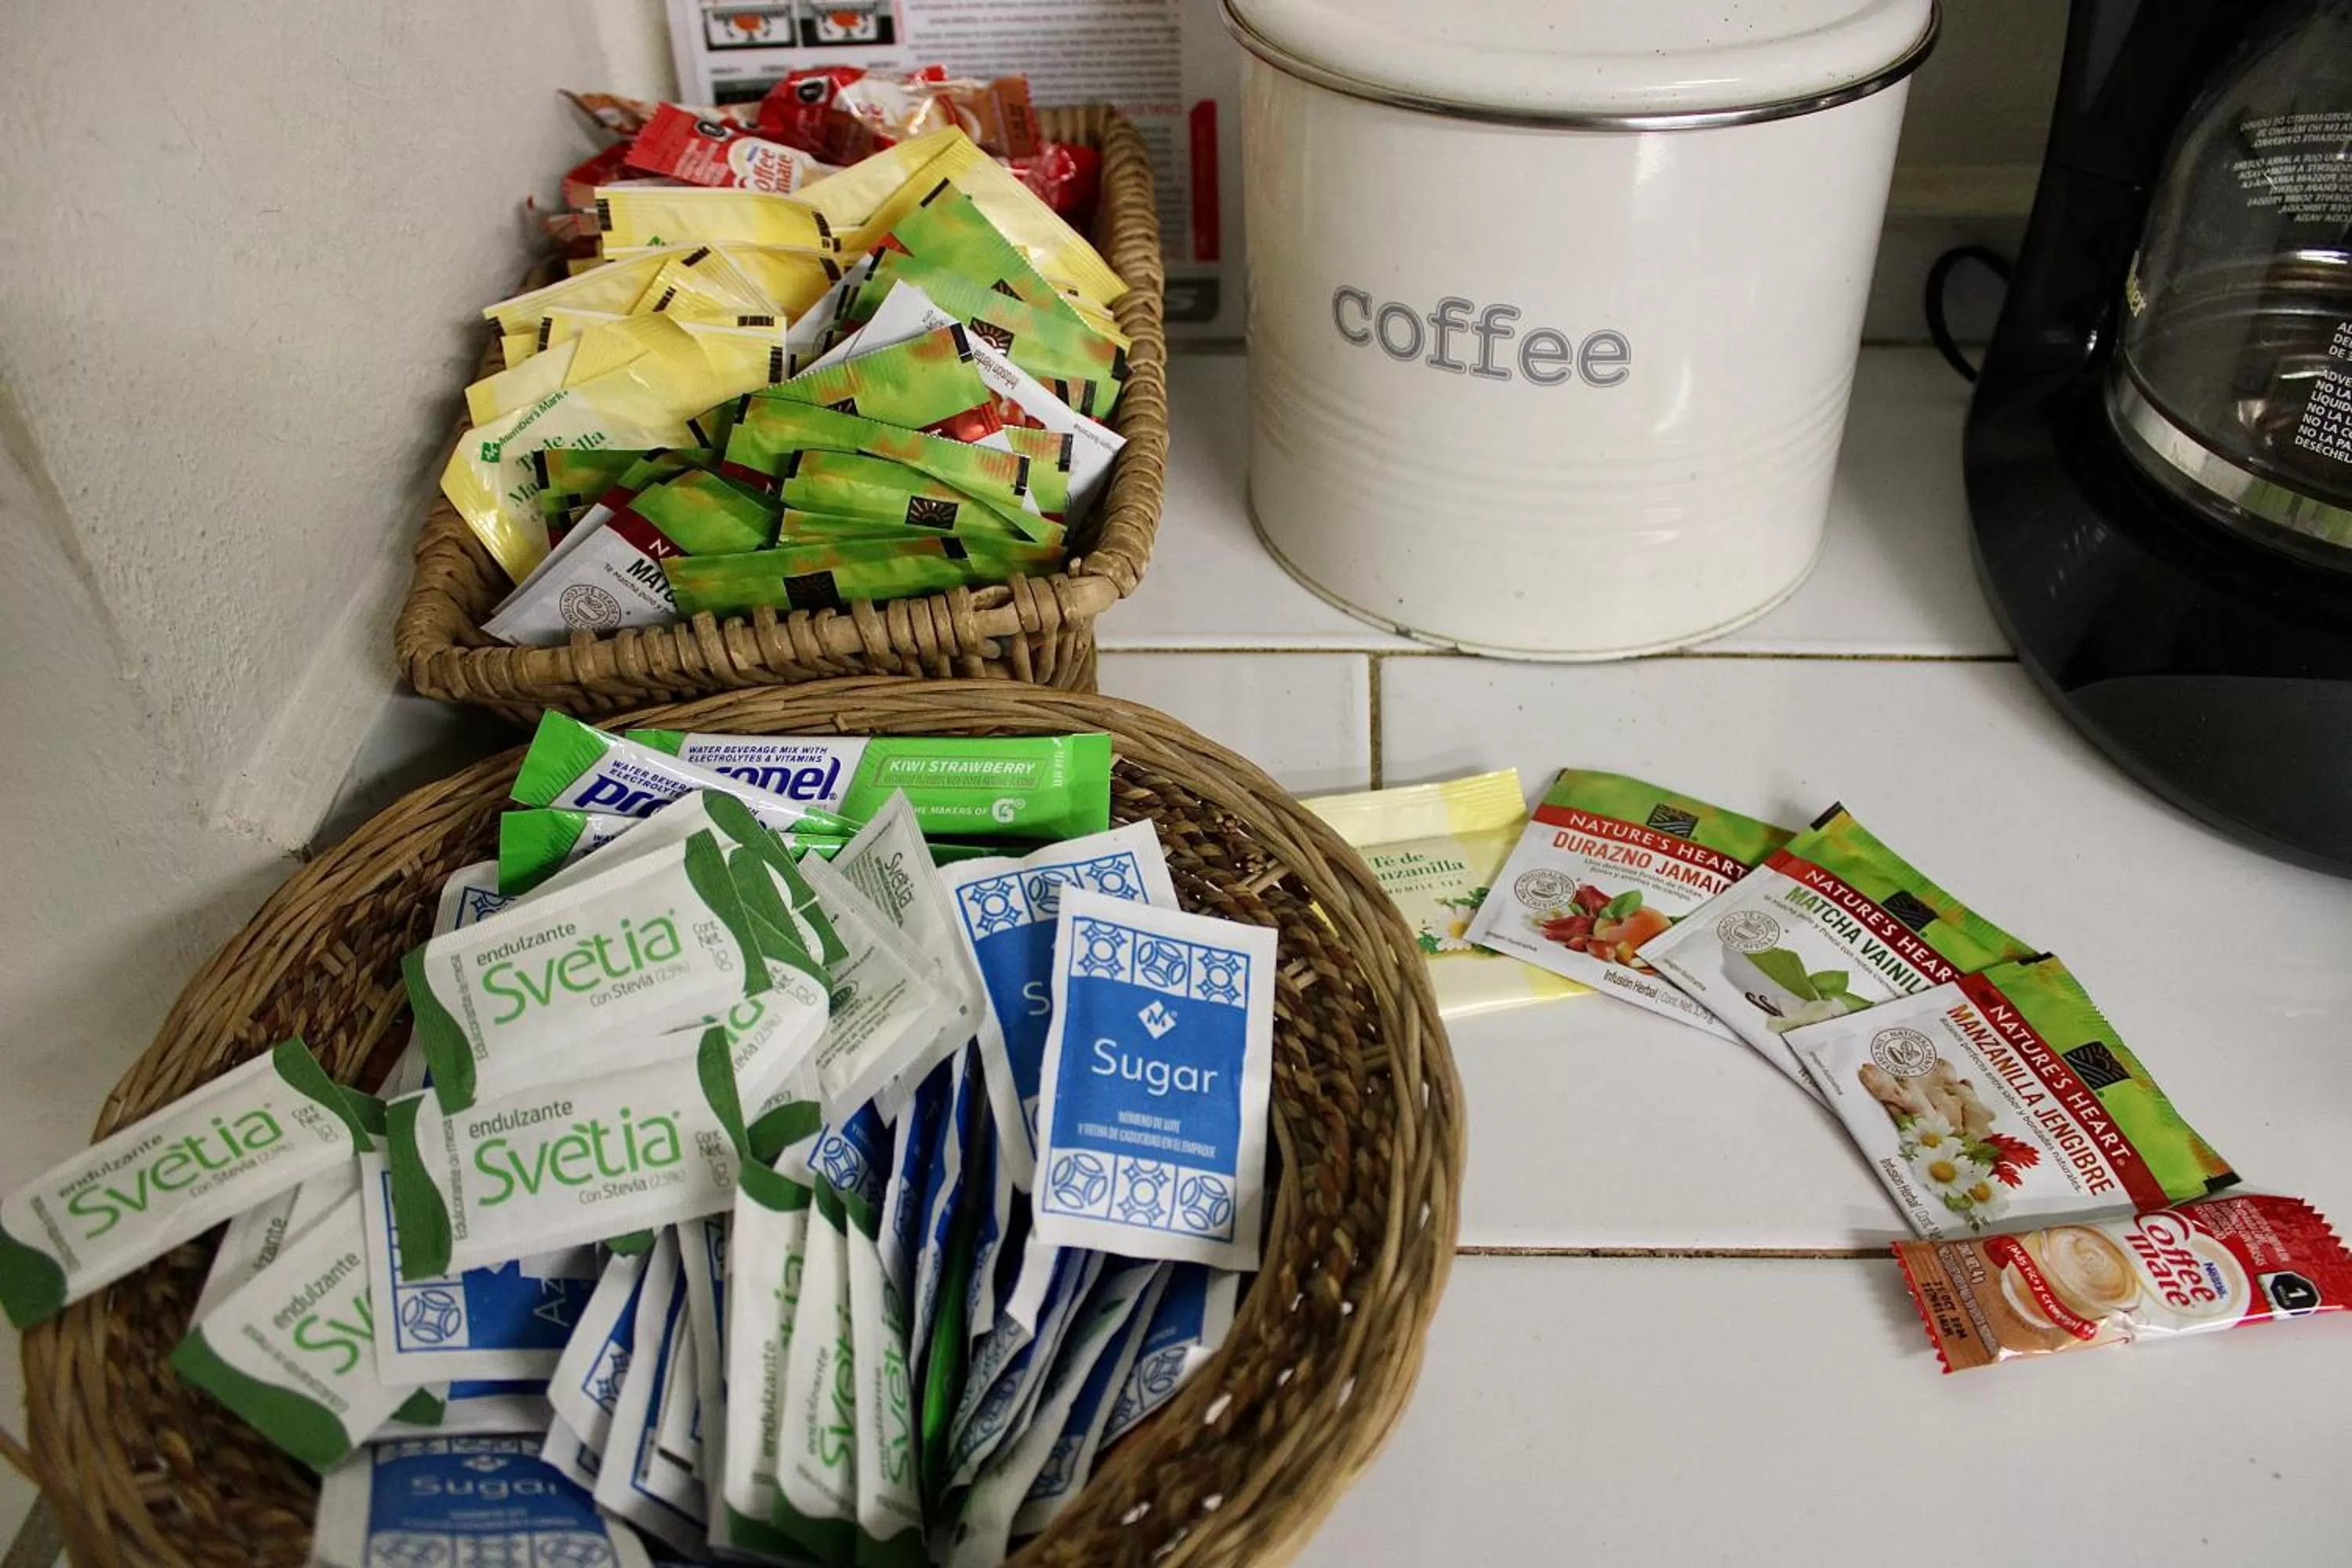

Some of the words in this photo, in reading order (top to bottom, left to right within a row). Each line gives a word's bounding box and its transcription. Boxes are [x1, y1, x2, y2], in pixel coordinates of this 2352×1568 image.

[1333, 285, 1632, 387] coffee
[539, 391, 565, 414] Mark
[2315, 379, 2334, 393] NO
[2336, 387, 2352, 401] LA
[2303, 413, 2321, 427] NO
[2323, 421, 2338, 434] LA
[2307, 402, 2325, 416] NO
[2328, 410, 2343, 423] LA
[2298, 424, 2317, 437] NO
[2318, 432, 2333, 445] LA
[612, 760, 650, 779] WATER
[688, 754, 761, 763] ELECTROLYTES
[779, 746, 799, 754] MIX
[800, 746, 829, 755] WITH
[890, 760, 926, 772] KIWI
[928, 760, 1036, 775] STRAWBERRY
[1552, 829, 1653, 869] DURAZNO
[1570, 812, 1671, 851] NATURE'S
[1678, 843, 1748, 879] HEART
[1784, 886, 1860, 944] MATCHA
[1805, 869, 1898, 937] NATURE'S
[1896, 935, 1960, 982] HEAR
[476, 921, 577, 967] endulzante
[589, 991, 612, 1009] Con
[612, 971, 655, 1000] Stevia
[1603, 969, 1634, 989] Infusión
[1632, 981, 1658, 998] Herbal
[1091, 1037, 1218, 1096] Sugar
[1989, 1005, 2073, 1090] NATURE'S
[2067, 1092, 2131, 1158] HEART
[469, 1099, 573, 1140] endulzante
[1947, 1004, 2047, 1106] MANZANILLA
[2033, 1108, 2115, 1196] JENGIBRE
[57, 1133, 164, 1198] endulzante
[212, 1158, 259, 1183] Stevia
[579, 1188, 603, 1205] Con
[602, 1178, 648, 1200] Stevia
[2123, 1234, 2191, 1308] mate
[2133, 1210, 2218, 1304] Coffee
[273, 1252, 361, 1330] endulzante
